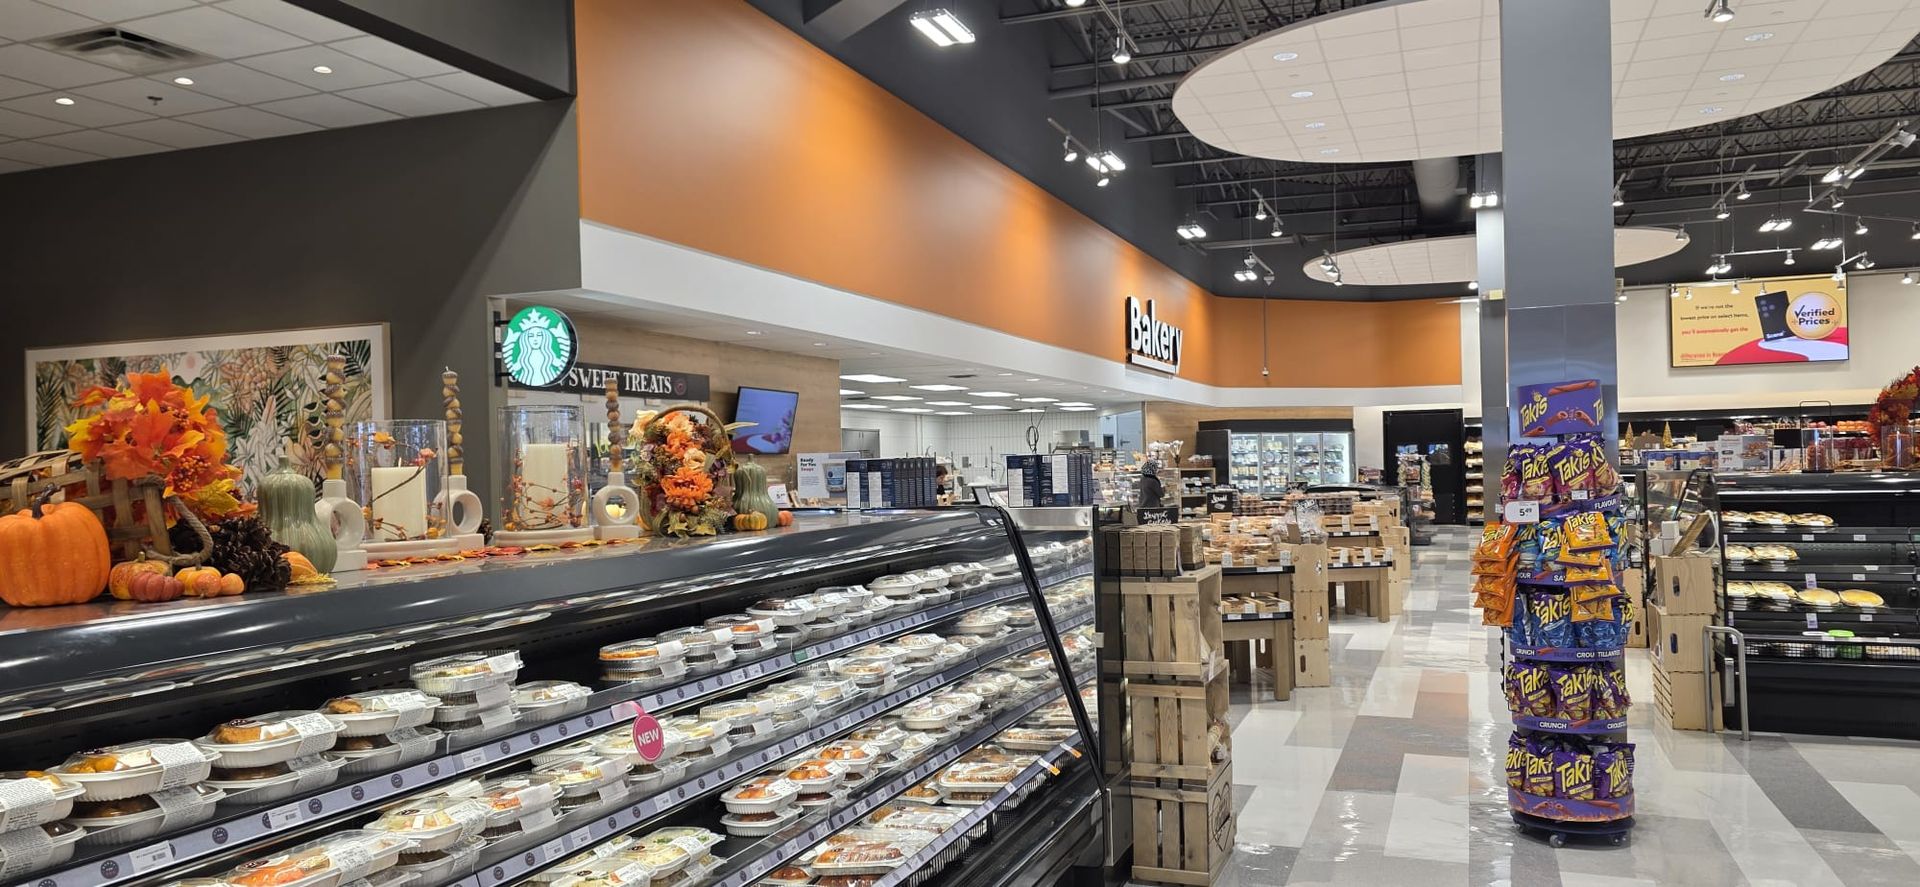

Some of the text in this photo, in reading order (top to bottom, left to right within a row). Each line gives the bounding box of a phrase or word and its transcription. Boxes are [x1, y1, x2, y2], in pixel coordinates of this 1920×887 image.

[1795, 305, 1835, 318] Verified
[1799, 317, 1830, 325] Prices
[1125, 295, 1183, 375] Bakery
[569, 367, 619, 389] SWEET
[623, 372, 672, 394] TREATS
[1521, 391, 1548, 432] Takis
[1555, 449, 1590, 485] Takis
[1594, 499, 1617, 510] FLAVOUR
[1567, 512, 1596, 531] Takis
[1533, 595, 1571, 627] Takis
[1539, 721, 1567, 729] CRUNCH
[637, 727, 659, 747] NEW
[1525, 752, 1554, 778] Taki
